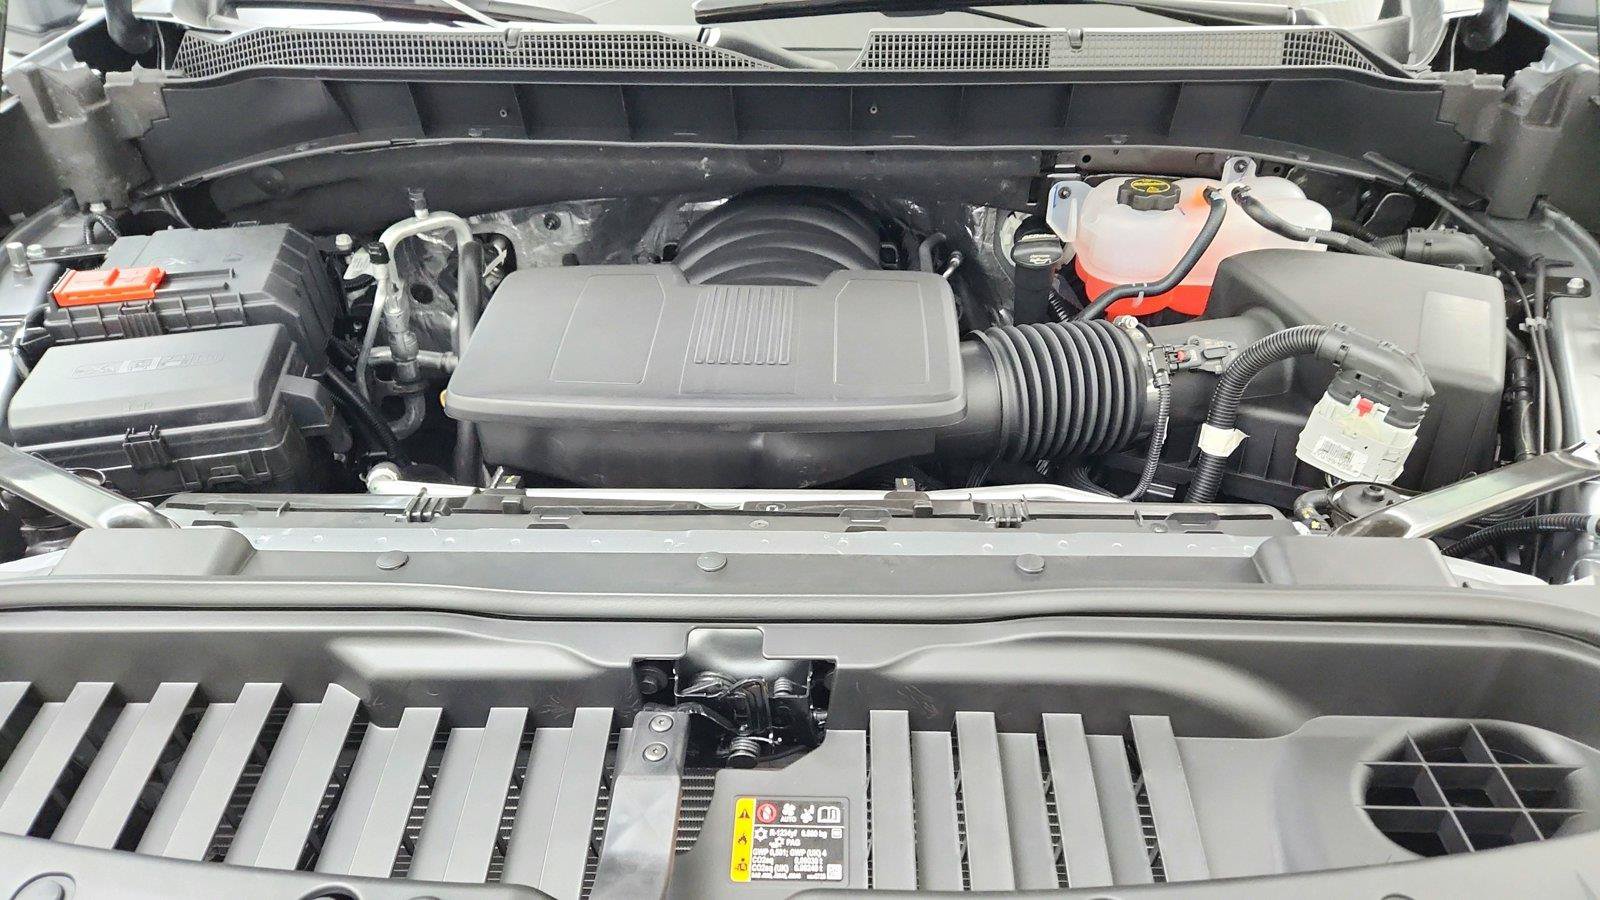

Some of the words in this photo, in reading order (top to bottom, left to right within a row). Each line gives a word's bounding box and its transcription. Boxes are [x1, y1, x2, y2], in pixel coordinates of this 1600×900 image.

[786, 838, 801, 847] PAG
[752, 848, 769, 856] GWP
[789, 849, 807, 857] GWP
